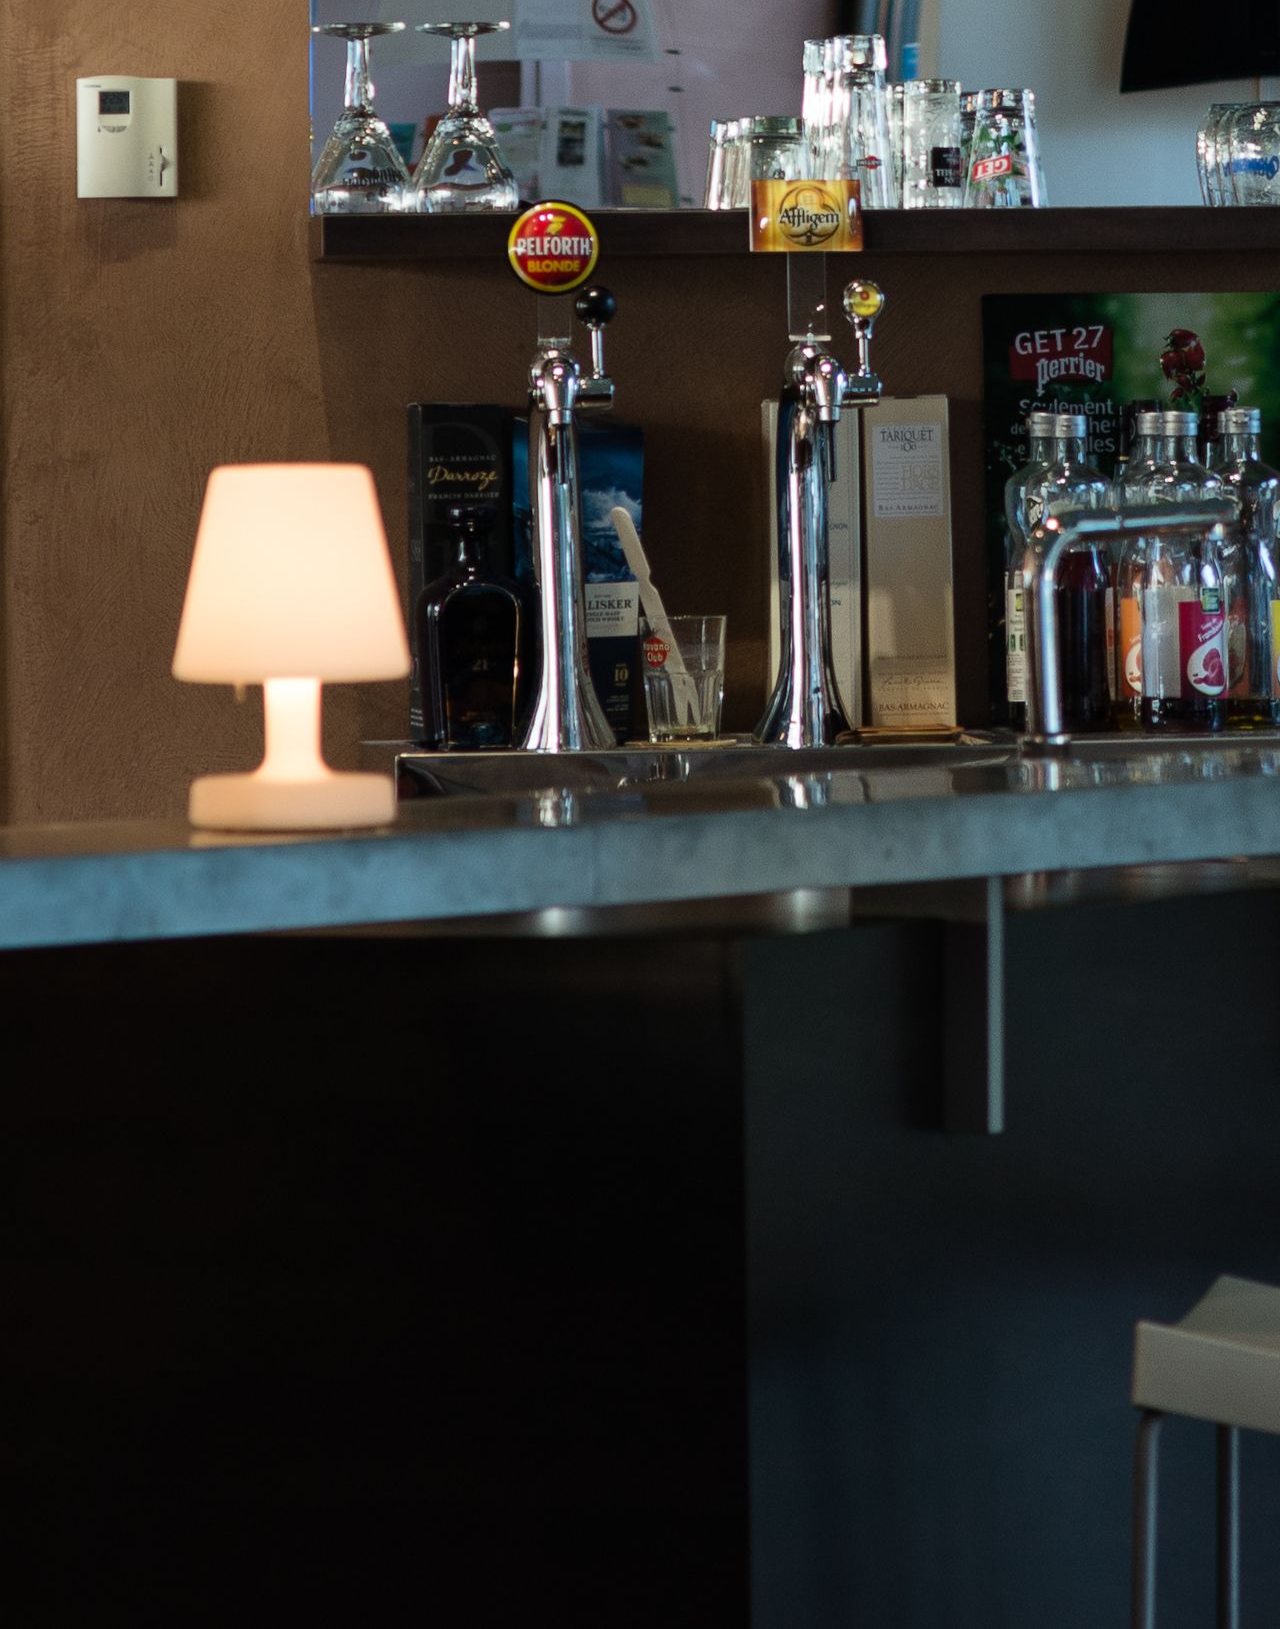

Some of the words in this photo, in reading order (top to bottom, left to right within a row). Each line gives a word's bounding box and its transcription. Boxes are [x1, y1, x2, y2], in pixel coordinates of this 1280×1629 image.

[975, 158, 1008, 178] GET
[779, 207, 840, 232] Affligem
[516, 236, 591, 256] PELFORTH
[527, 259, 581, 273] BLONDE
[1014, 328, 1067, 355] GET
[1071, 325, 1105, 349] 27
[1035, 352, 1105, 397] perrier
[427, 465, 498, 491] Darroze
[614, 668, 629, 683] 10
